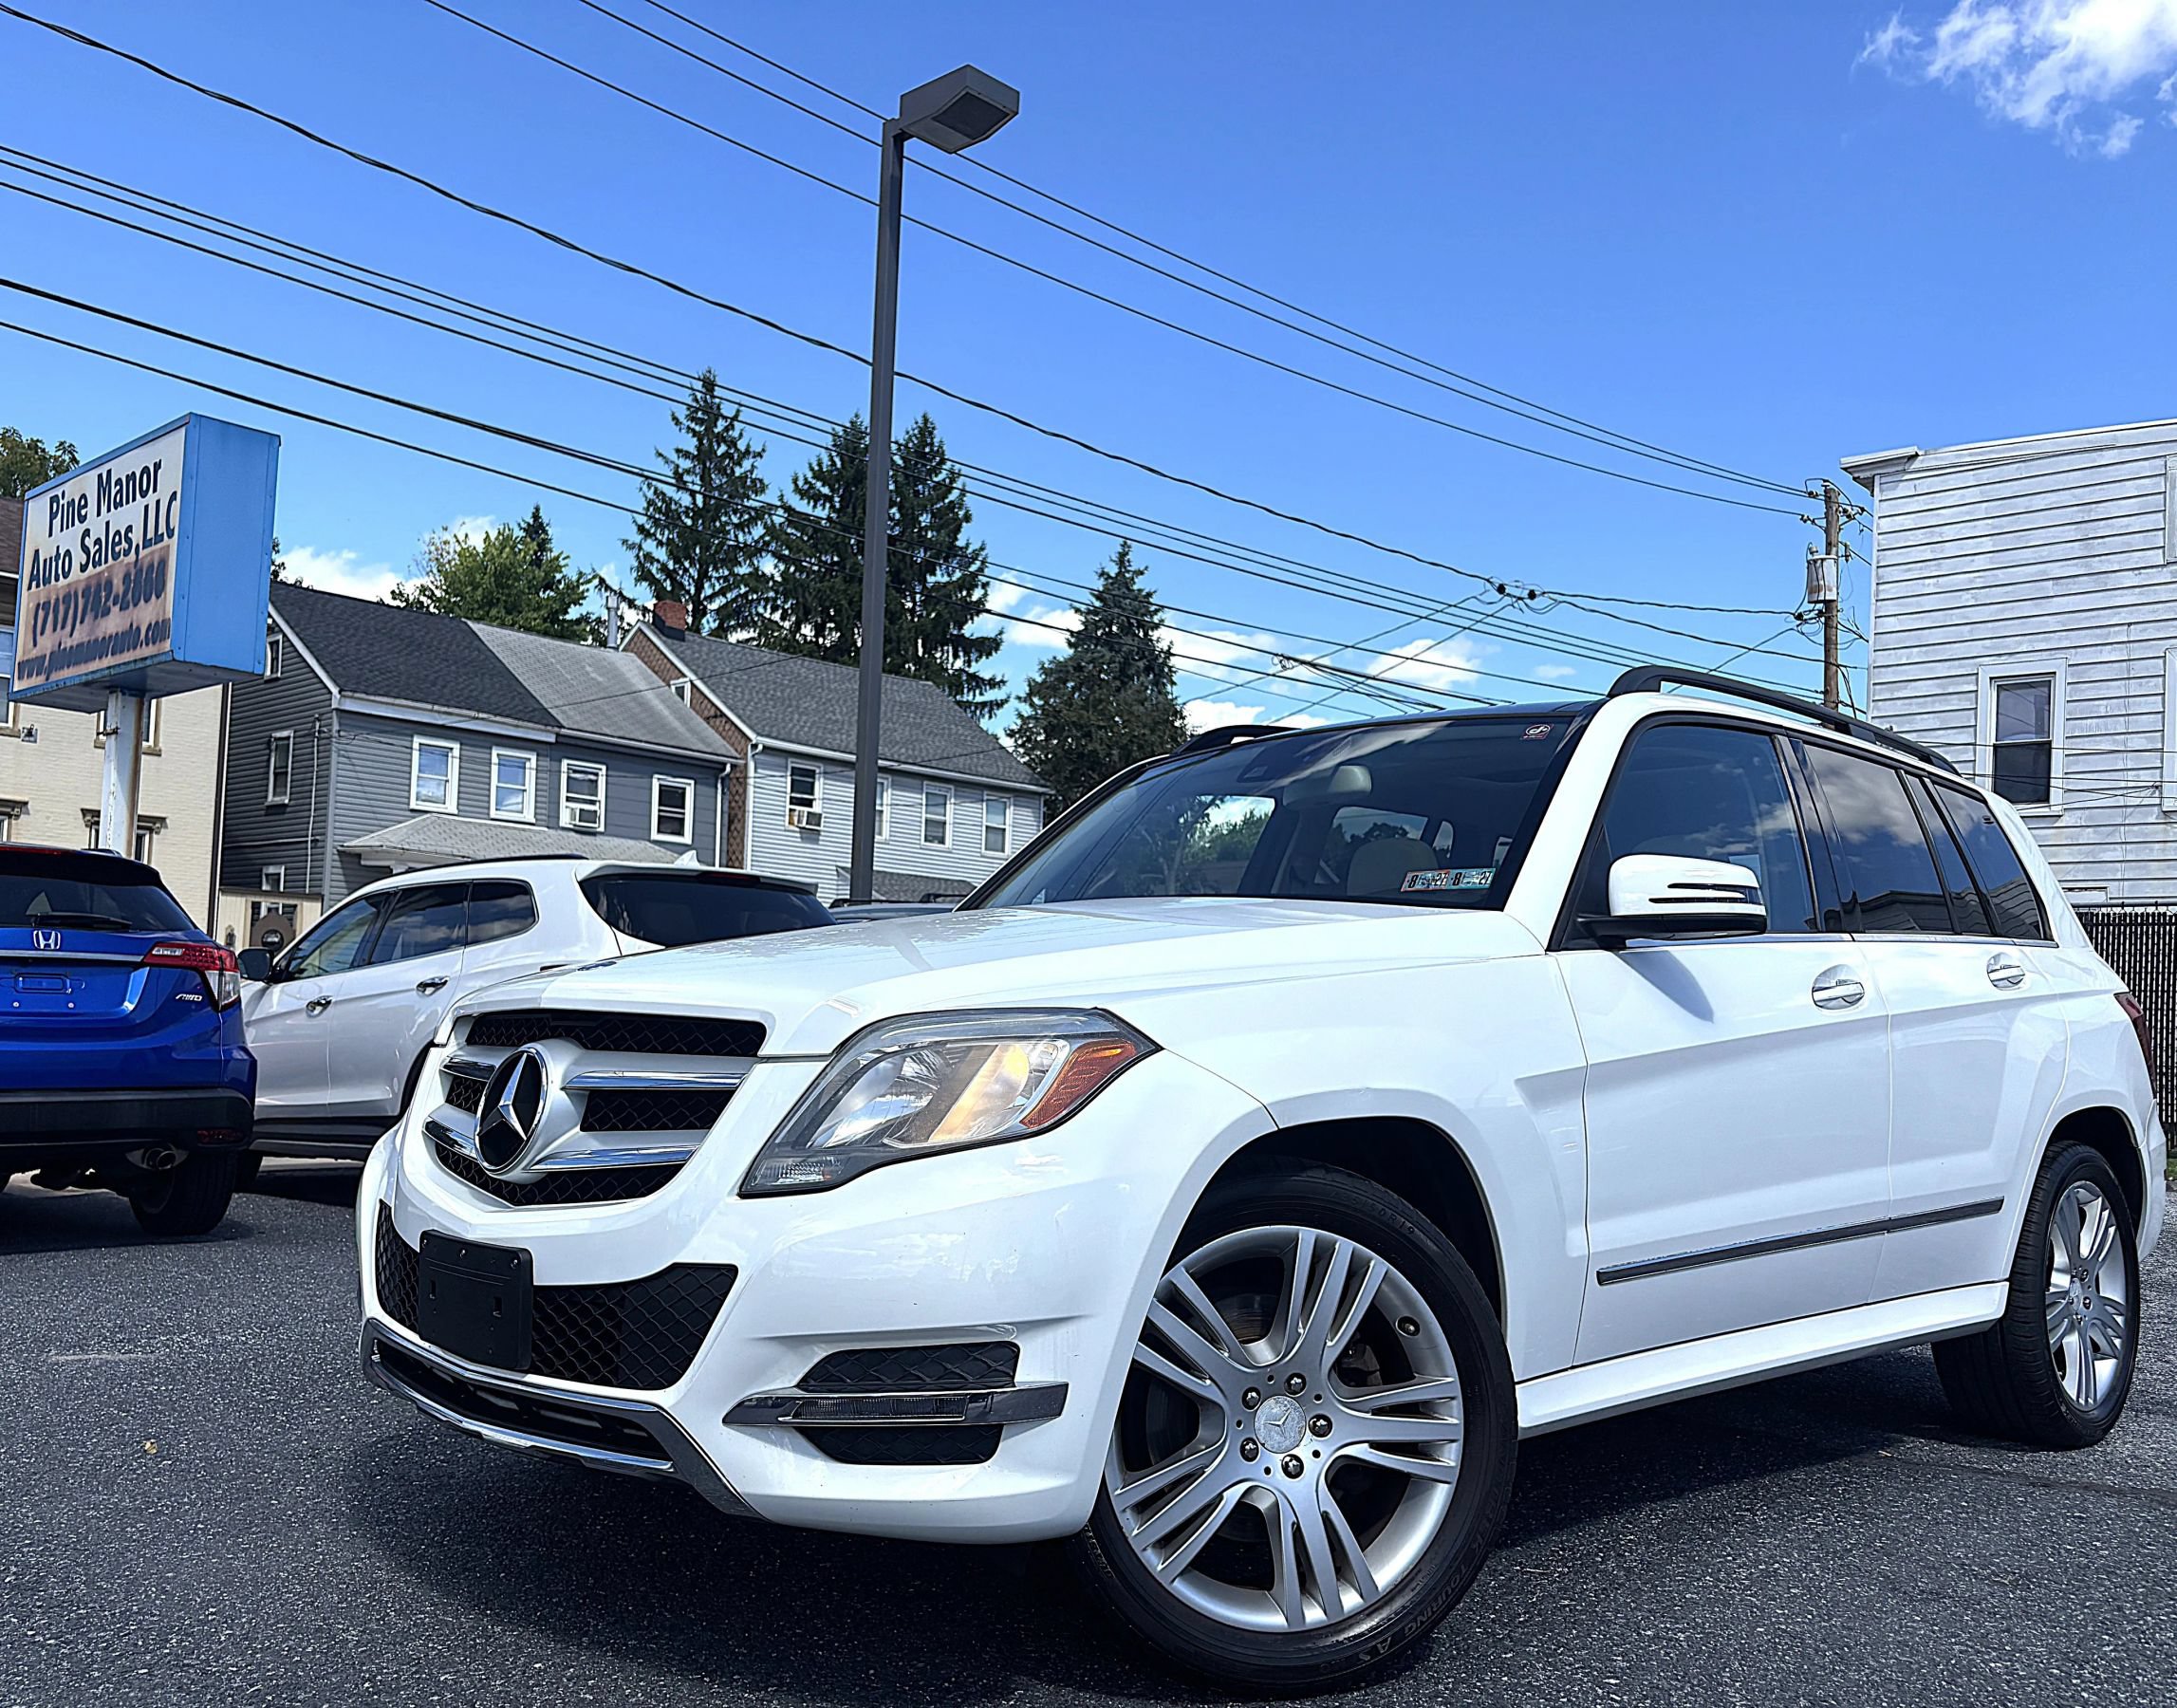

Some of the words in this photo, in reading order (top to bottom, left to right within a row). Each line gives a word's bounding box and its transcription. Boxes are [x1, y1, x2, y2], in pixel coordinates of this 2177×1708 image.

[47, 490, 88, 538] Pine
[96, 458, 162, 518] Manor
[27, 545, 73, 591] Auto
[175, 993, 202, 1002] AWD
